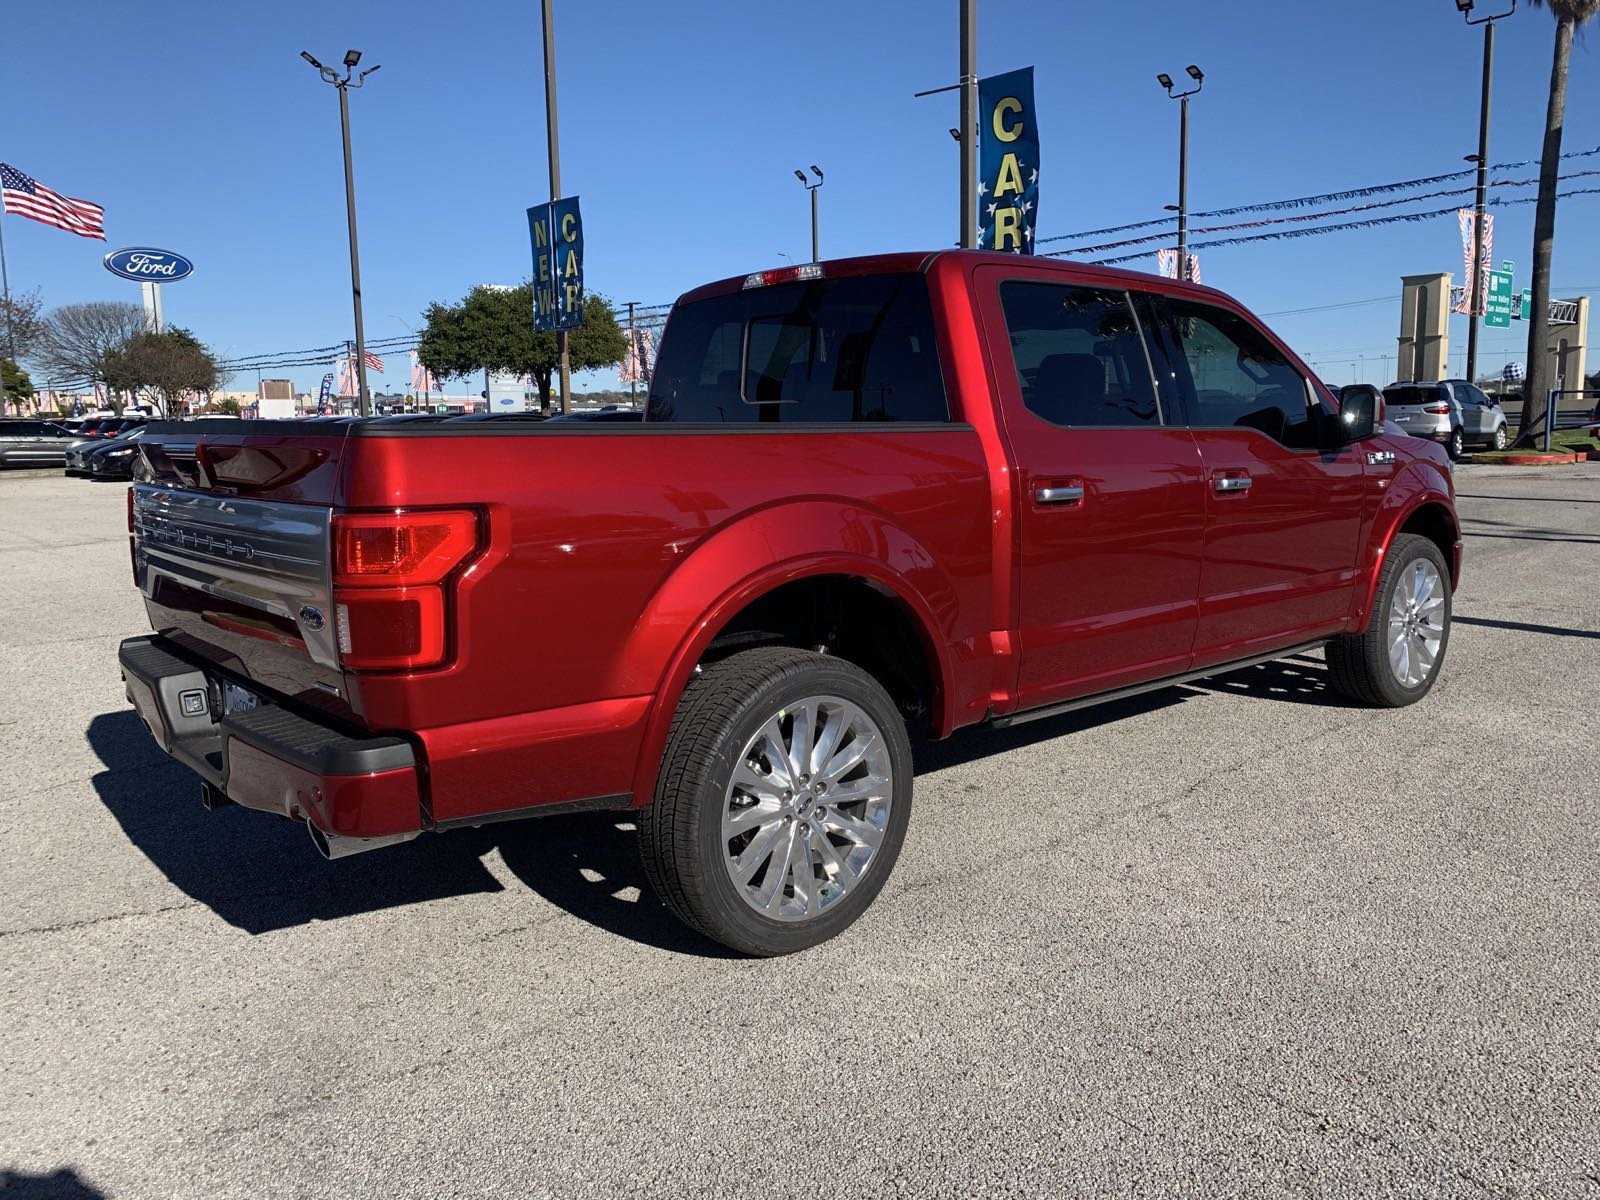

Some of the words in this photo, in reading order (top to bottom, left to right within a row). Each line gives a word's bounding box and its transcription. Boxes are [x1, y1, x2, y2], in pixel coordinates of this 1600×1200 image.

[992, 97, 1025, 250] CAR
[126, 253, 177, 276] Ford
[534, 219, 550, 316] NEW
[561, 213, 578, 313] CAR
[1487, 304, 1495, 312] San
